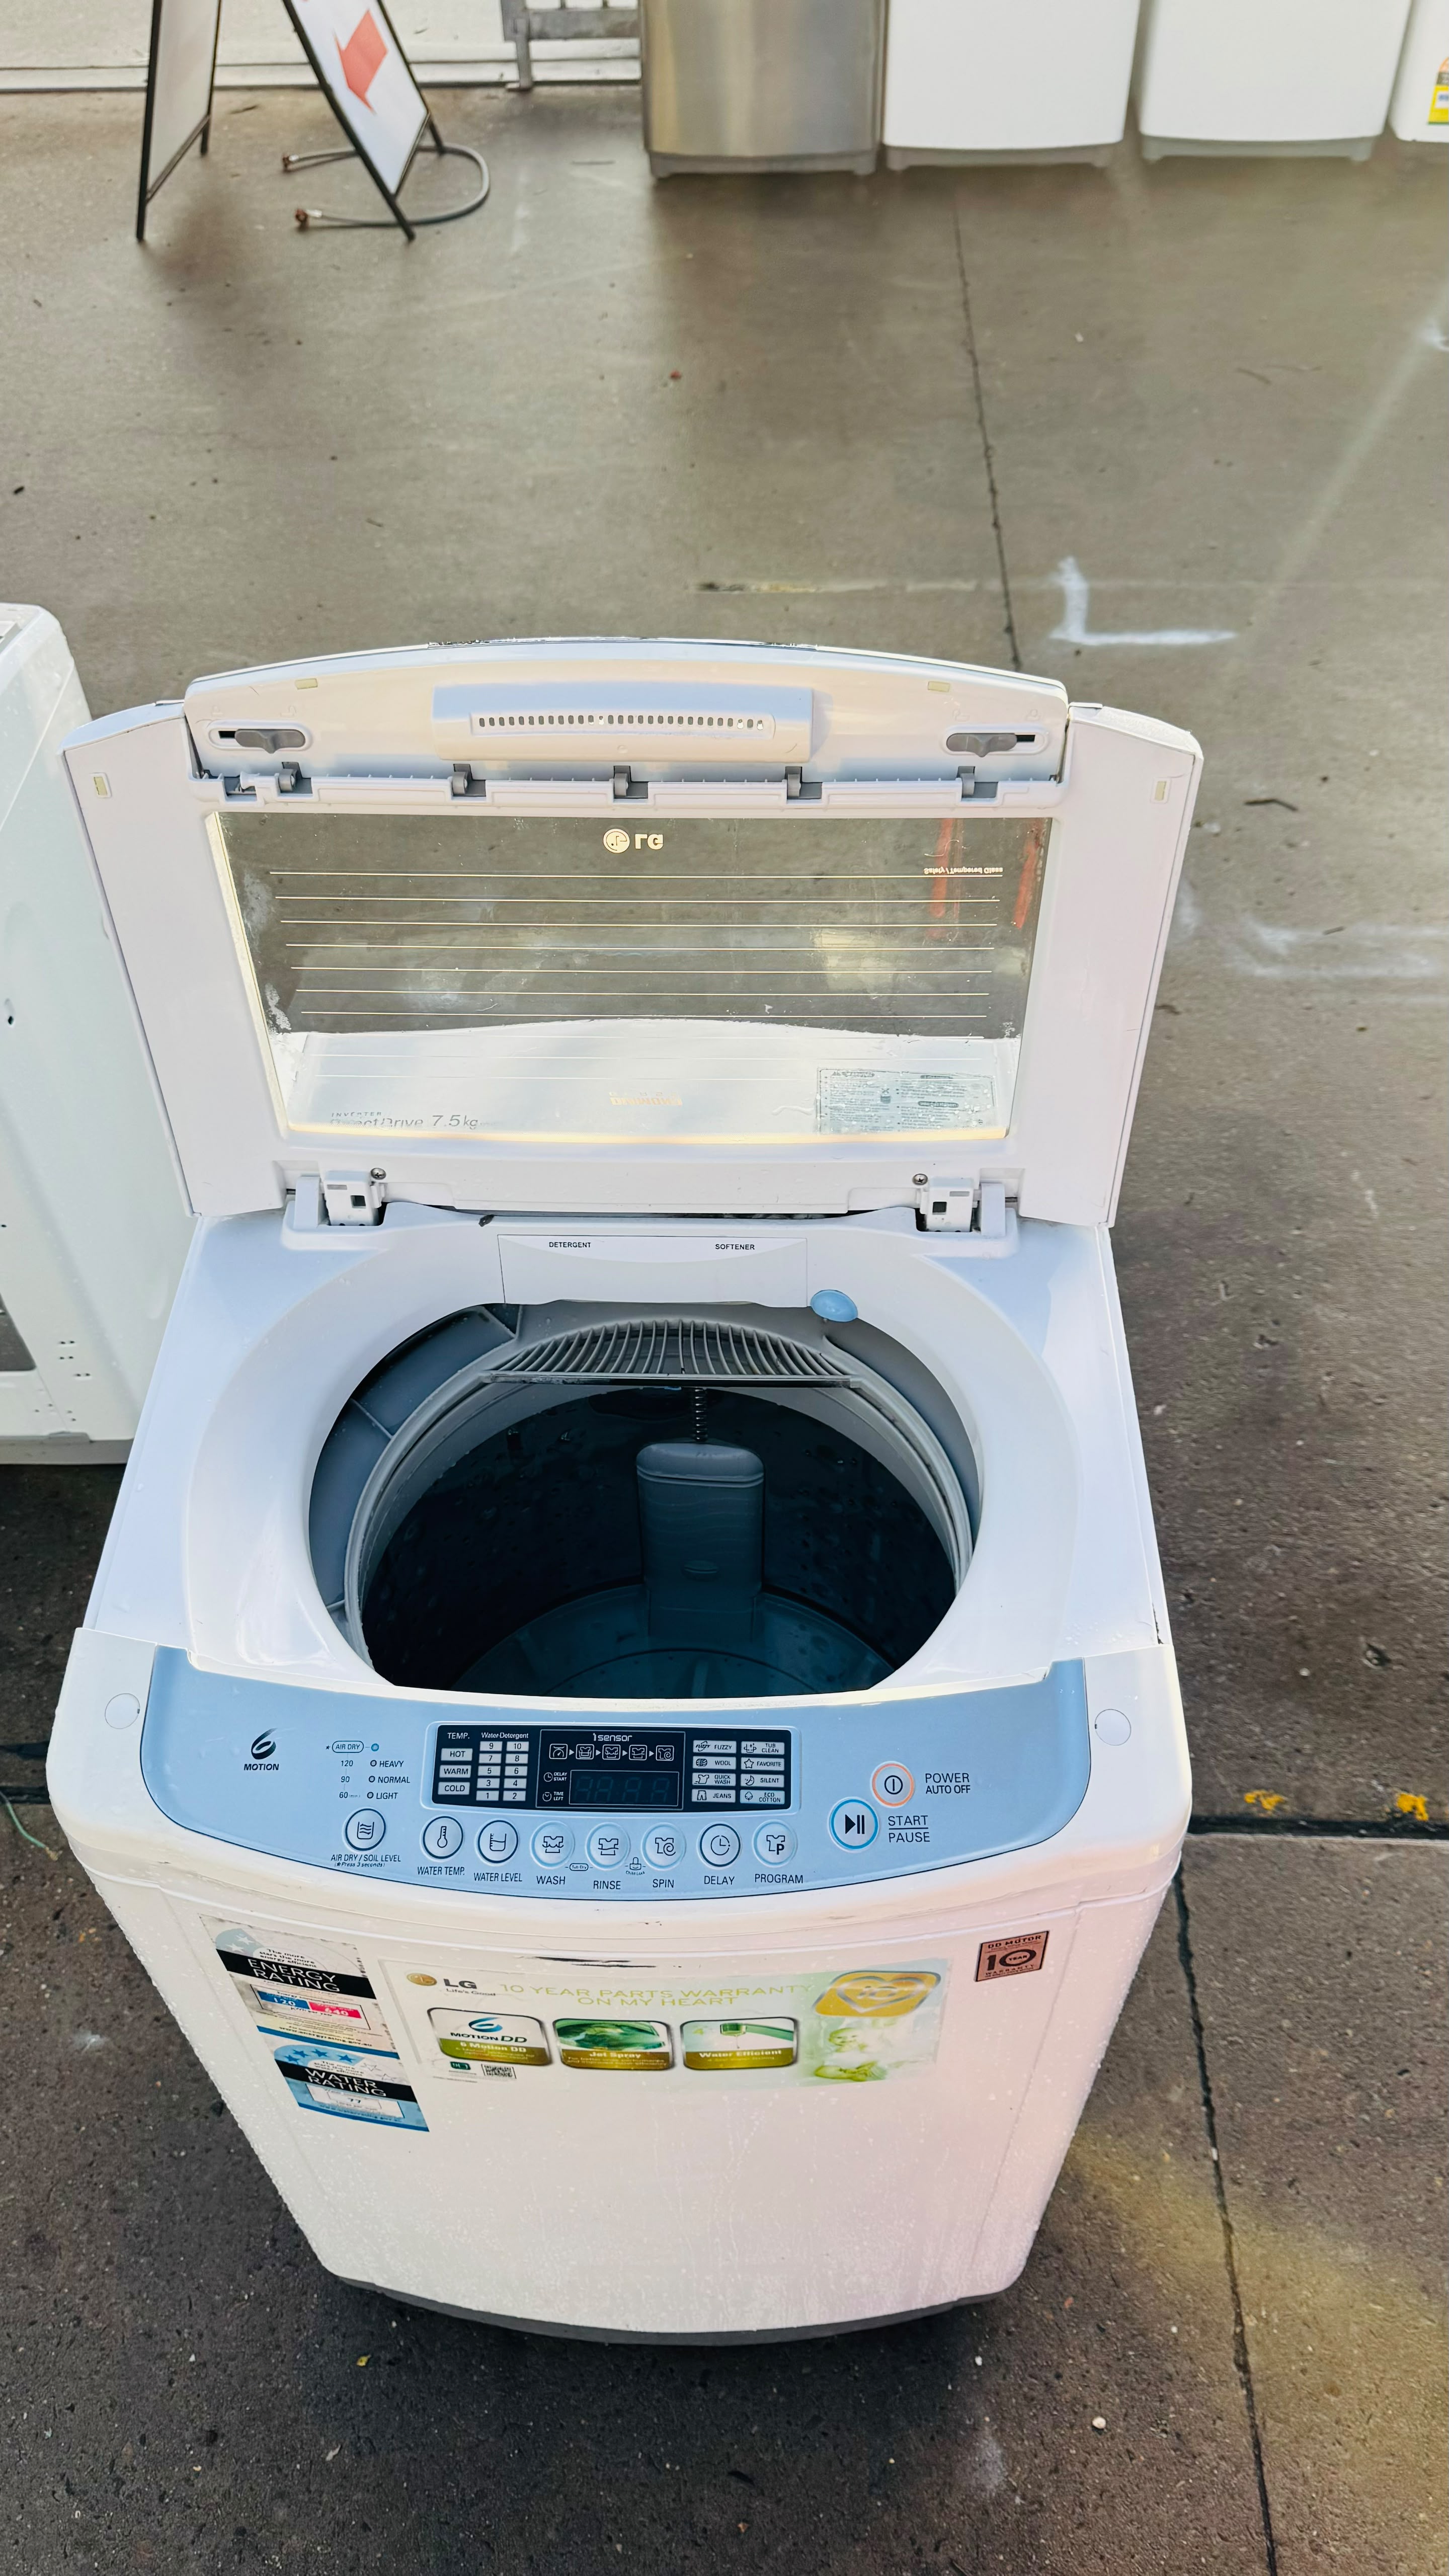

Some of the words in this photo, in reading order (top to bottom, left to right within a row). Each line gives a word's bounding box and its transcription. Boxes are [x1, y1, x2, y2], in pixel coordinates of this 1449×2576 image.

[925, 1773, 970, 1783] POWER
[926, 1785, 951, 1794] AUTO
[954, 1785, 971, 1794] OFF
[888, 1815, 928, 1826] START
[889, 1832, 930, 1843] PAUSE
[417, 1867, 443, 1876] WATER
[444, 1867, 465, 1876] TEMP.
[473, 1873, 499, 1882] WATER
[501, 1873, 523, 1883] LEVEL
[536, 1876, 566, 1885] WASH
[704, 1876, 735, 1885] DELAY
[755, 1874, 803, 1884] PROGRAM
[593, 1880, 621, 1890] RINSE
[652, 1879, 675, 1888] SPIN
[248, 1959, 336, 1982] ENERGY
[253, 1969, 340, 1992] RATING
[444, 1979, 477, 1989] LG
[500, 1984, 524, 1993] 10
[530, 1986, 590, 1996] YEAR
[600, 1989, 673, 1998] PARTS
[681, 1985, 812, 1997] WARRANTY
[578, 1997, 611, 2005] ON
[661, 1996, 738, 2006] HEART
[450, 2032, 499, 2041] MOTION
[305, 2068, 377, 2088] WATER
[308, 2076, 386, 2097] RATING
